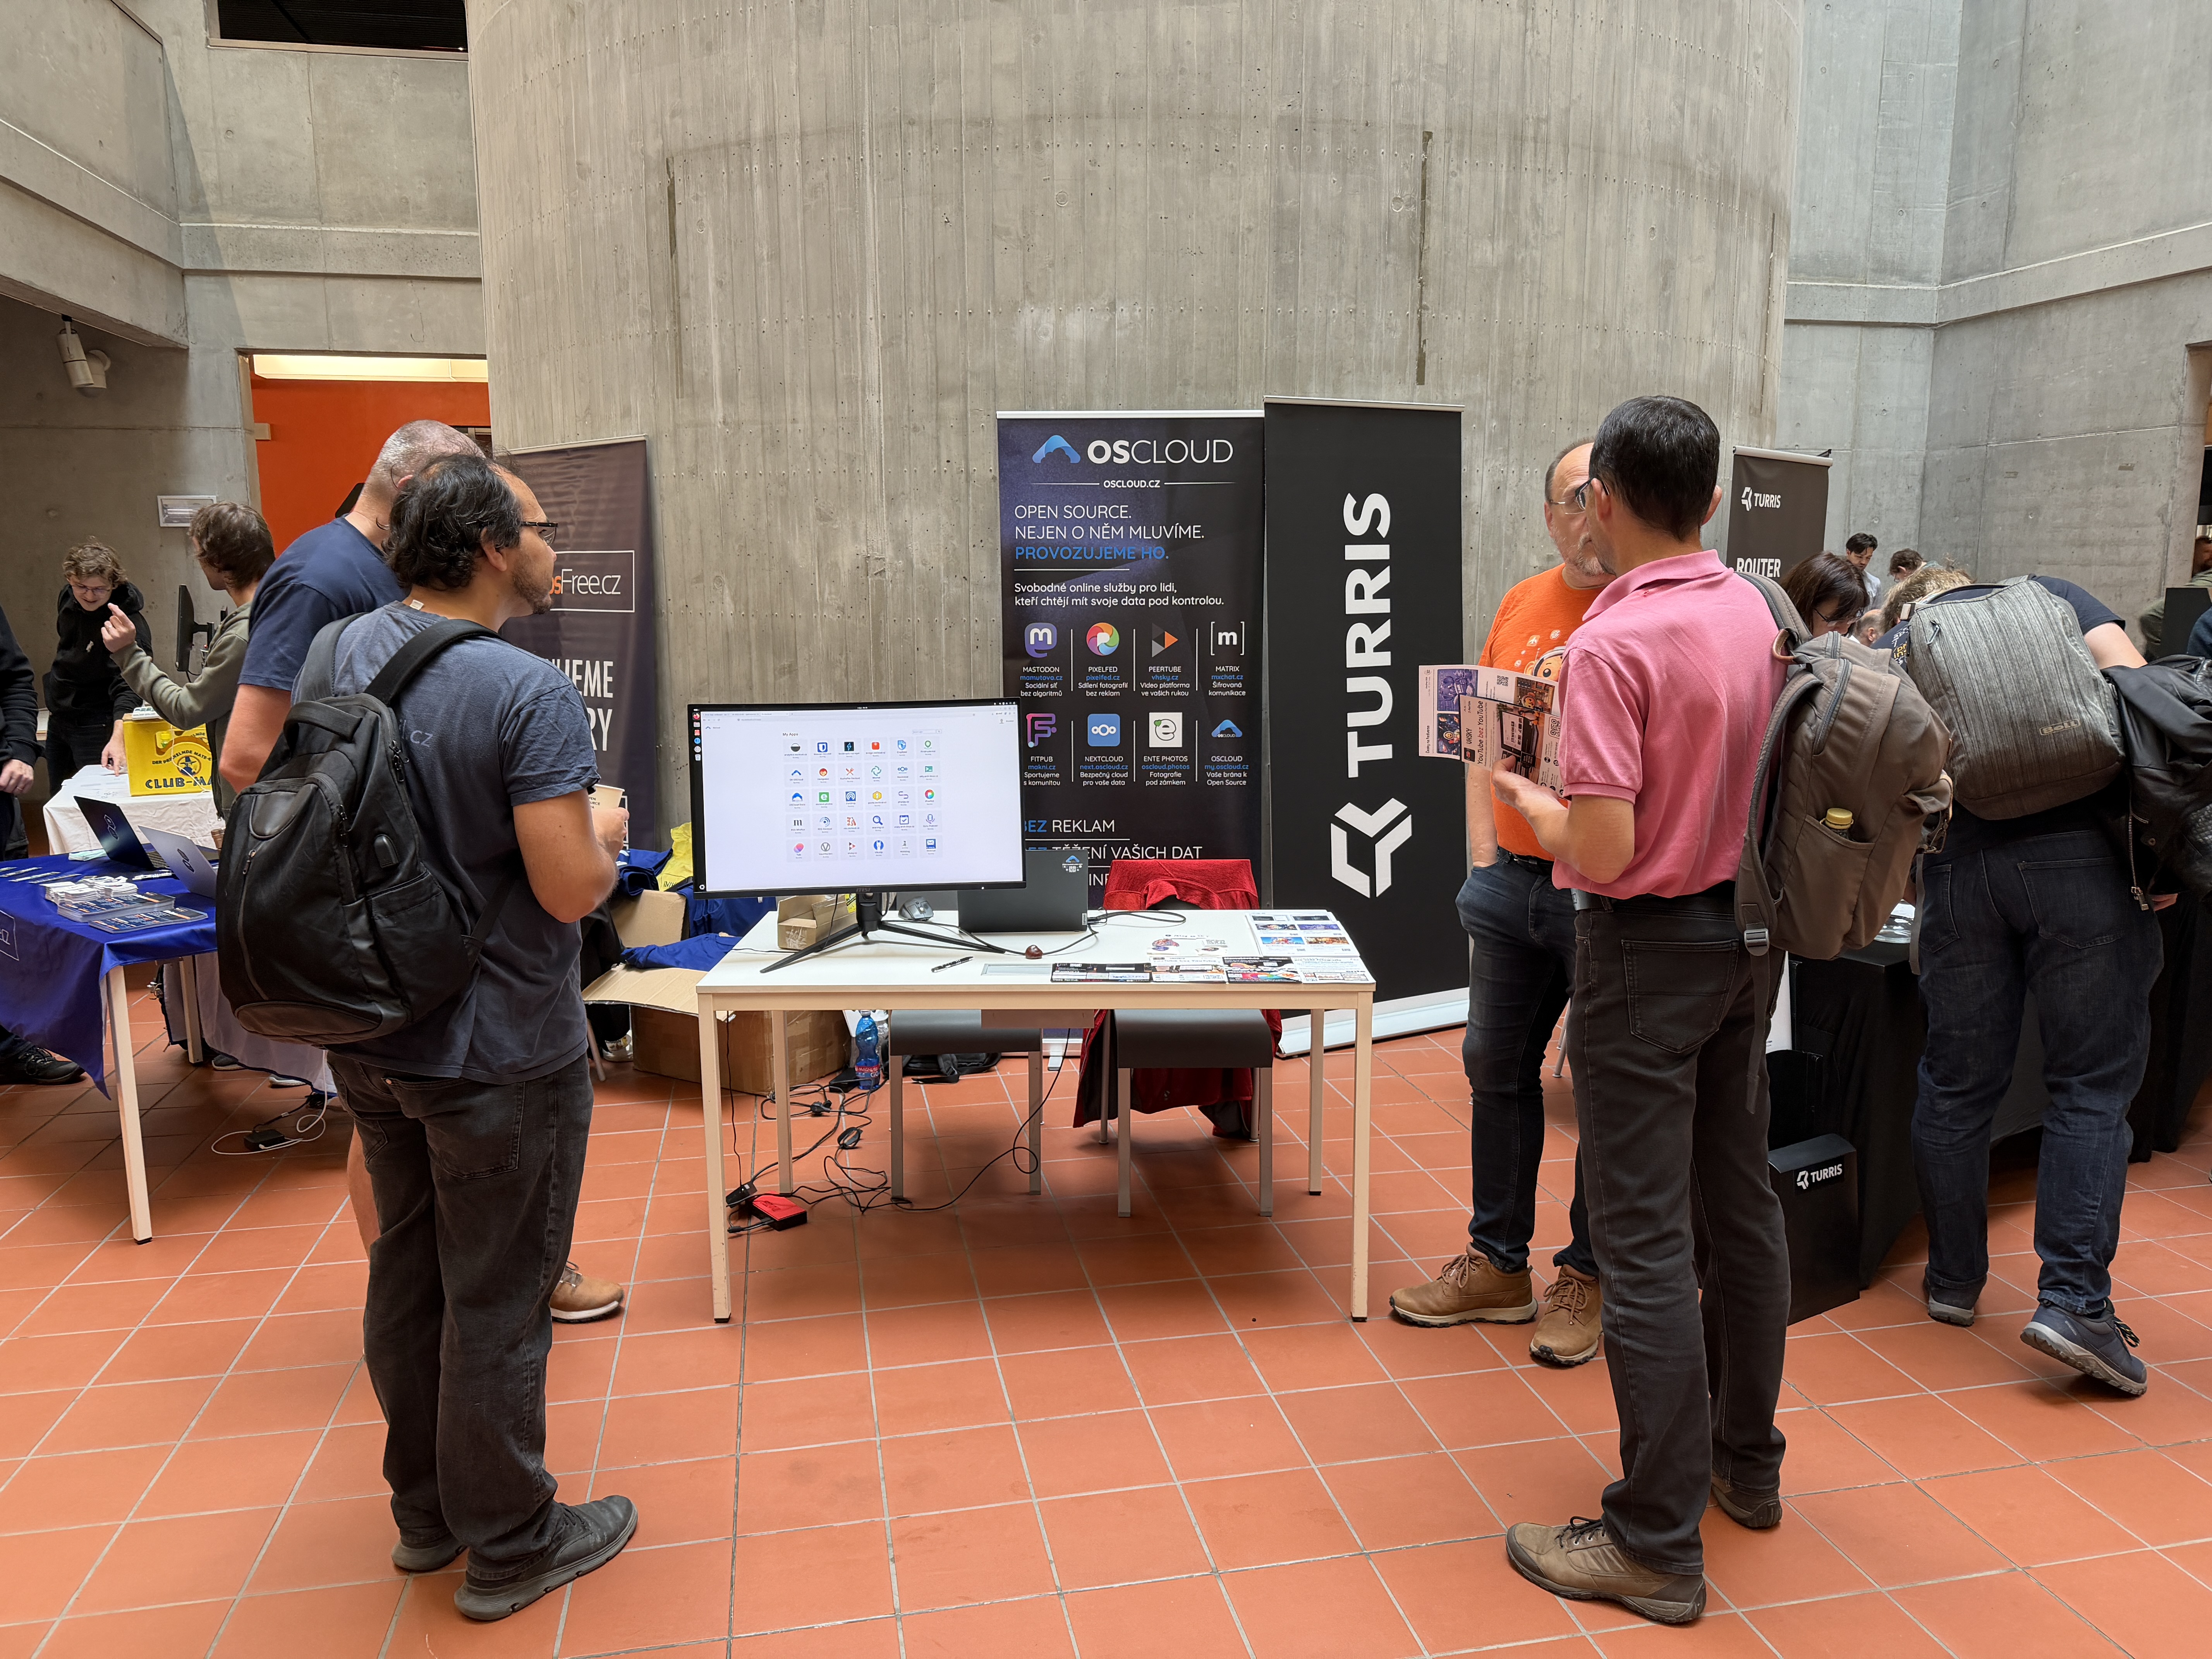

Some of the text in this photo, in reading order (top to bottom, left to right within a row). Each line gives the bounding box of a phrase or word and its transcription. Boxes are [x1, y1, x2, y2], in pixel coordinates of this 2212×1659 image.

[1087, 439, 1233, 464] OSCLOUD
[1103, 479, 1161, 488] OSCLOUD.CZ
[1754, 493, 1781, 509] TURRIS
[1015, 505, 1132, 519] OPEN SOURCE.
[1015, 522, 1204, 539] NEJEN O NĚM MLUVÍME.
[1015, 546, 1169, 560] PROVOZUJEME HO.
[1736, 558, 1781, 578] ROUTER
[1015, 582, 1177, 595] Svobodné online služby pro lidi,
[1015, 595, 1224, 608] kteří chtějí mít svoje data pod kontrolou.
[1343, 493, 1393, 778] TURRIS
[1086, 674, 1120, 682] pixelfed.cz
[1099, 682, 1128, 690] fotografií
[1159, 682, 1190, 690] platforma
[1032, 690, 1063, 698] algoritmů
[1141, 763, 1190, 772] oscloud.photos
[1204, 763, 1249, 771] my.oscloud.cz
[1080, 771, 1110, 779] Bezpečný
[1149, 771, 1182, 779] Fotografie
[1145, 779, 1158, 787] pod
[1206, 779, 1224, 787] Open
[1052, 819, 1115, 833] REKLAM
[1111, 844, 1166, 859] VAŠICH
[1172, 846, 1203, 859] DAT
[1810, 1164, 1843, 1183] TURRIS
